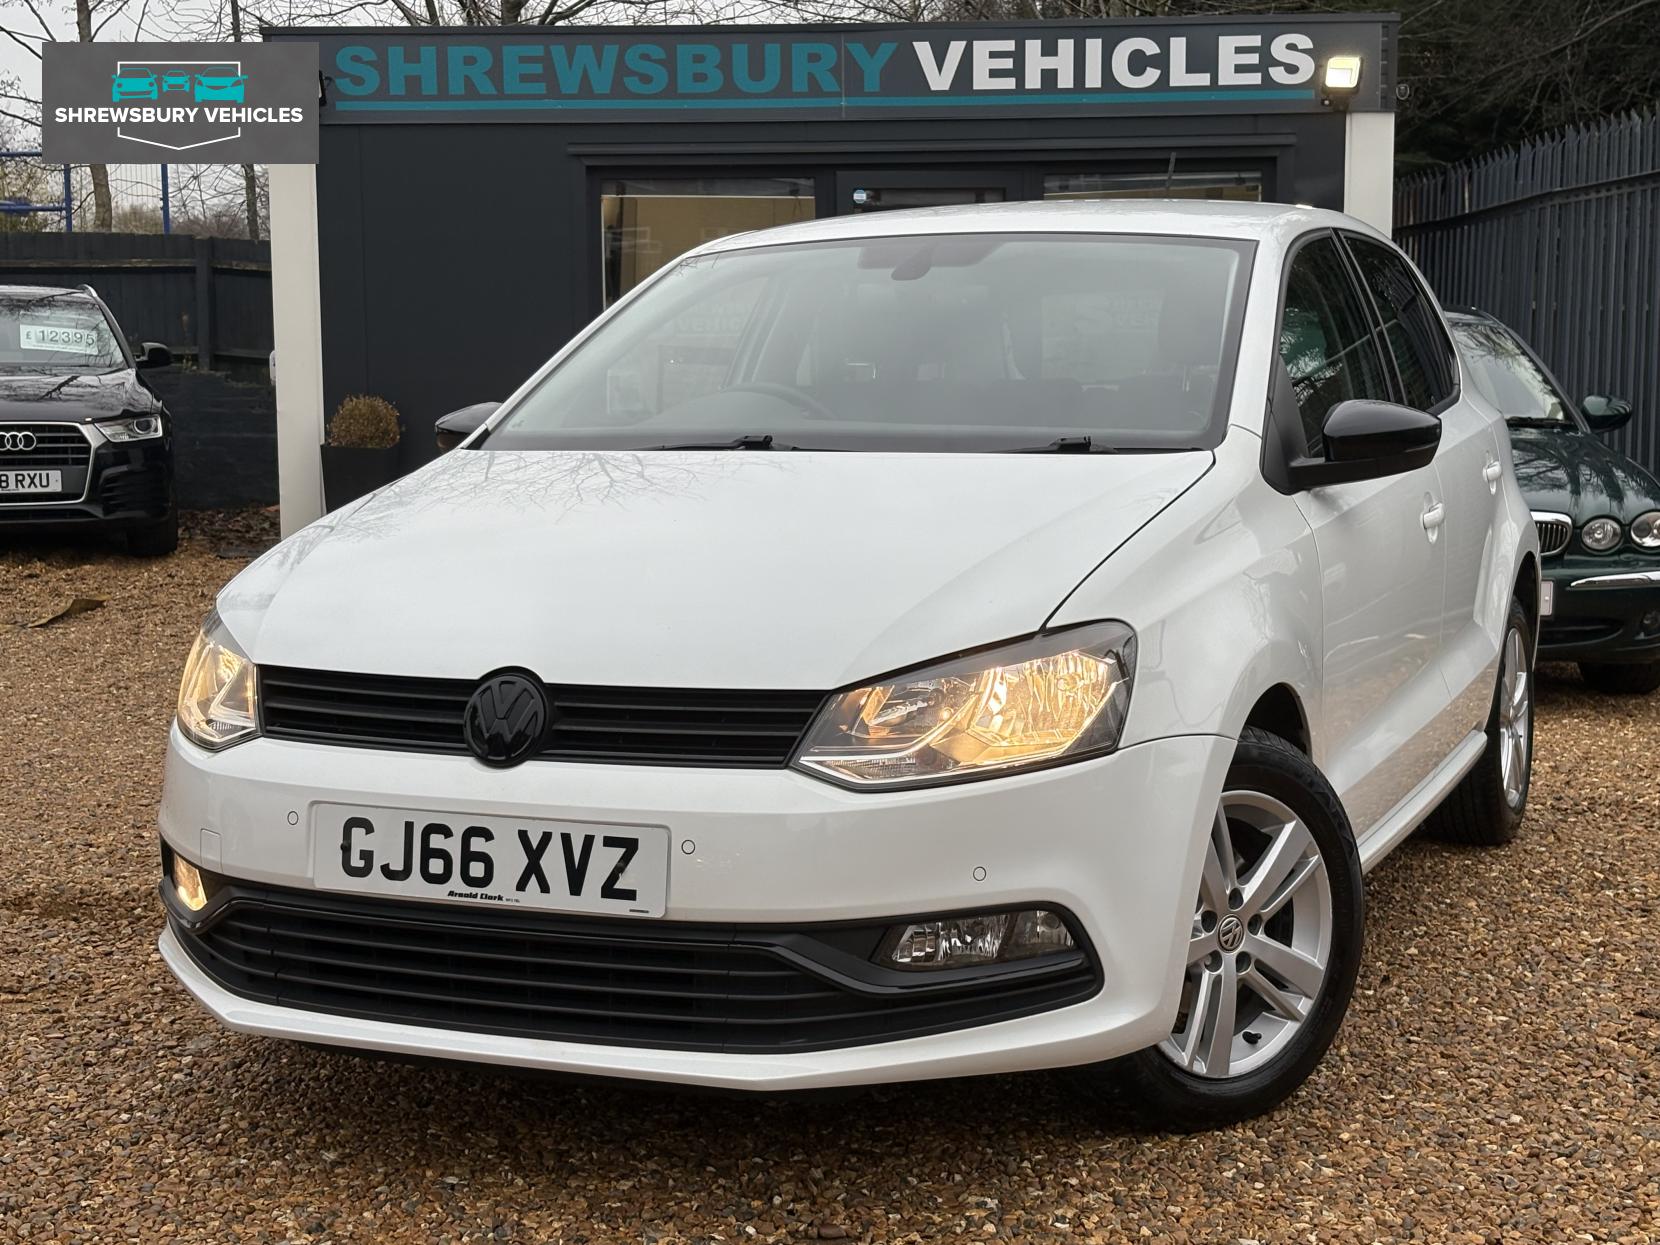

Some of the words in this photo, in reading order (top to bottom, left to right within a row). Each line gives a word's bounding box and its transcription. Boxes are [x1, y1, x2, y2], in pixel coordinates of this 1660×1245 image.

[334, 42, 897, 97] SHREWSBURY
[912, 33, 1316, 91] VEHICLES
[38, 329, 95, 346] 12395
[15, 472, 50, 489] RXU
[341, 816, 494, 889] GJ66
[515, 829, 639, 902] XVZ
[447, 890, 479, 899] Arnold
[479, 893, 504, 902] Clark
